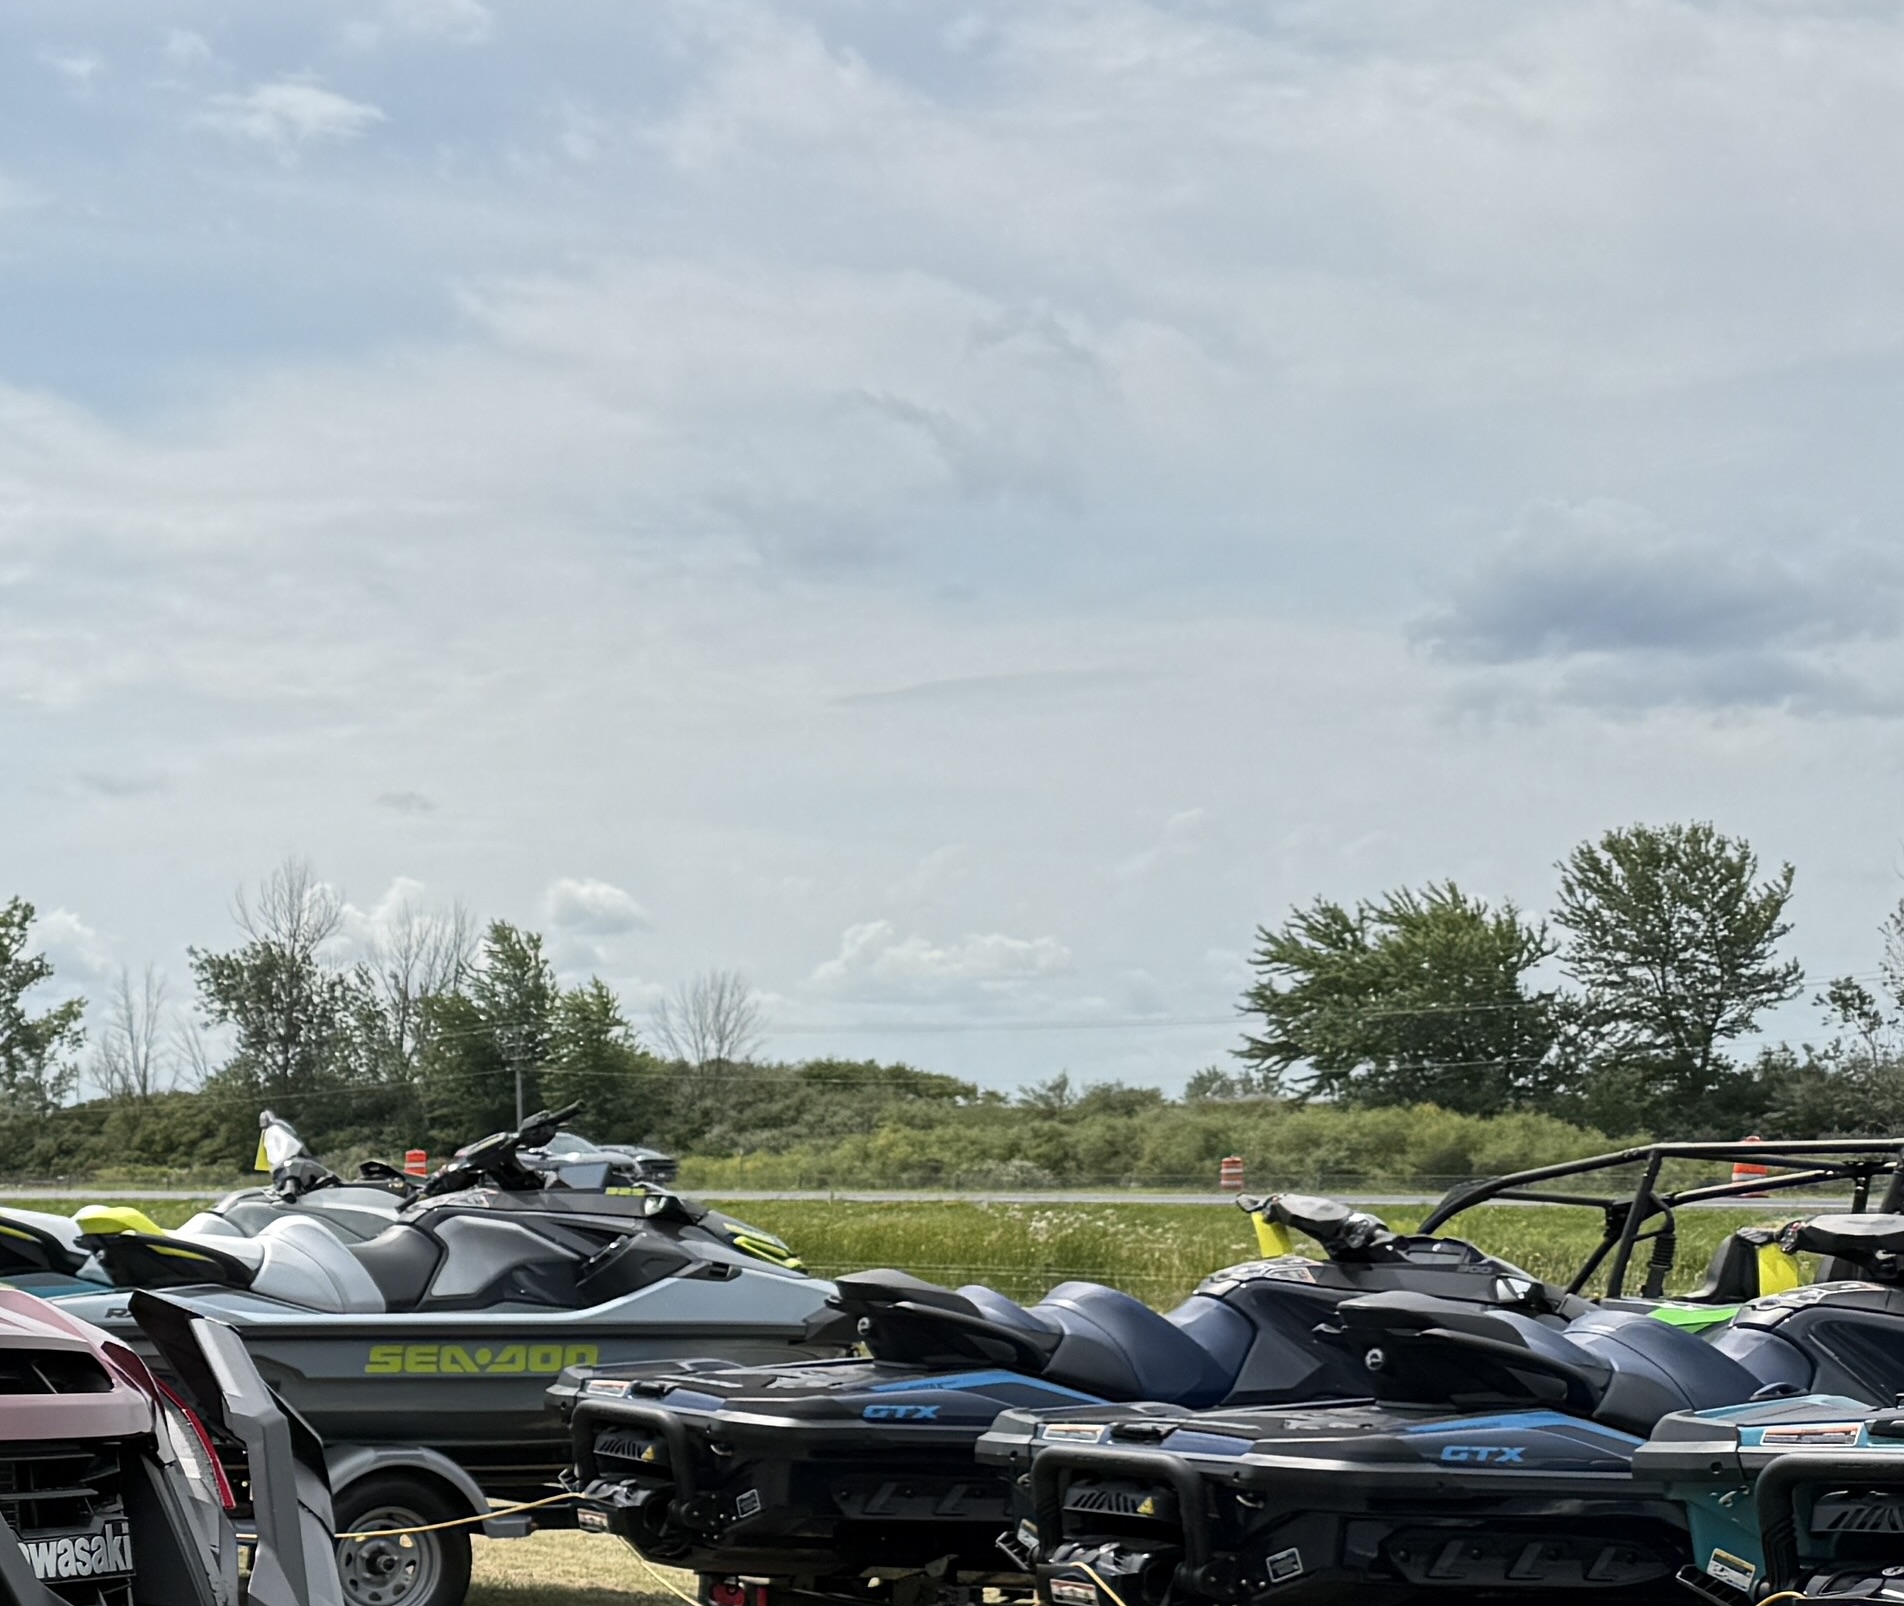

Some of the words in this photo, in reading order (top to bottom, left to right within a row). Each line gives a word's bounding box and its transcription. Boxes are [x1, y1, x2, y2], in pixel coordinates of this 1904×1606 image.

[862, 1404, 942, 1419] GTX
[1439, 1445, 1527, 1463] GTX
[17, 1521, 134, 1579] wasaki
